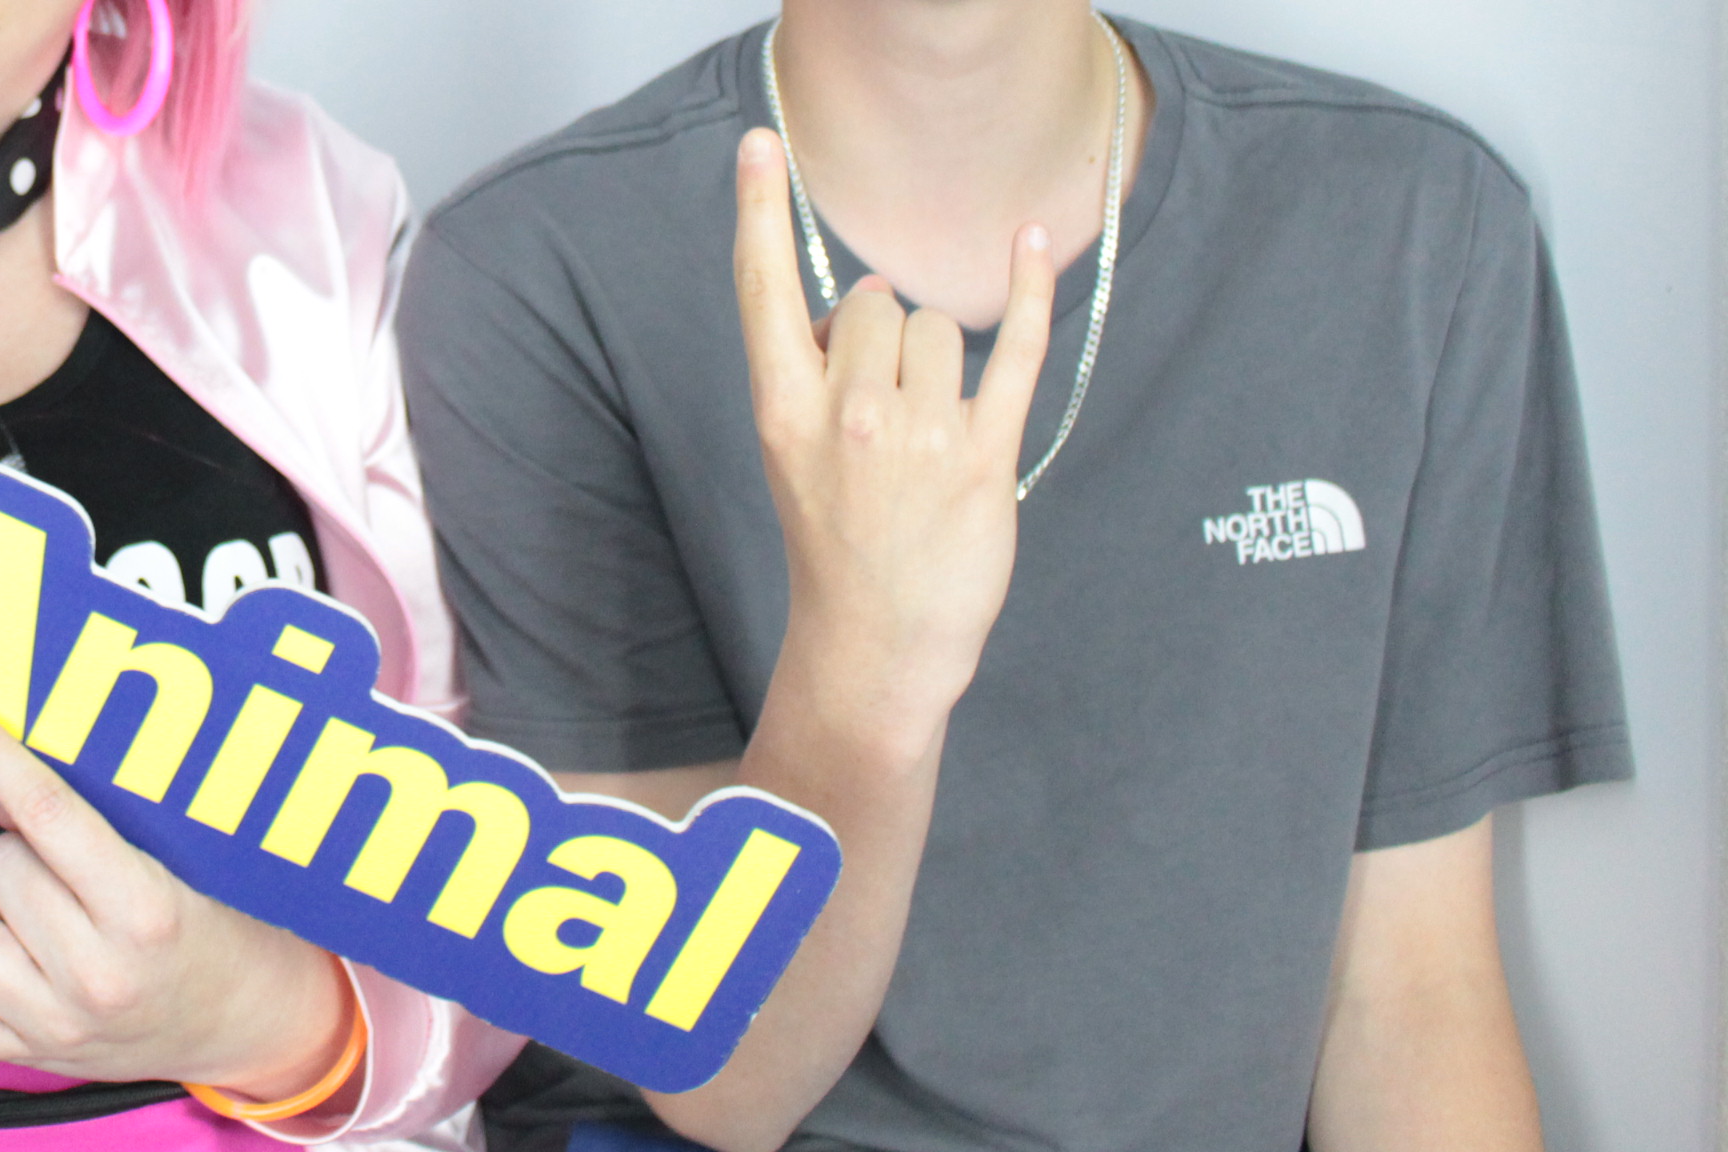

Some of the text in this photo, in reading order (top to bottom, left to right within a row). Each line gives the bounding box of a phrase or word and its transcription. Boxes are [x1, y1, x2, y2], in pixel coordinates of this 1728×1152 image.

[1245, 480, 1306, 513] THE
[1202, 506, 1310, 546] NORTH
[1237, 531, 1313, 566] FACE
